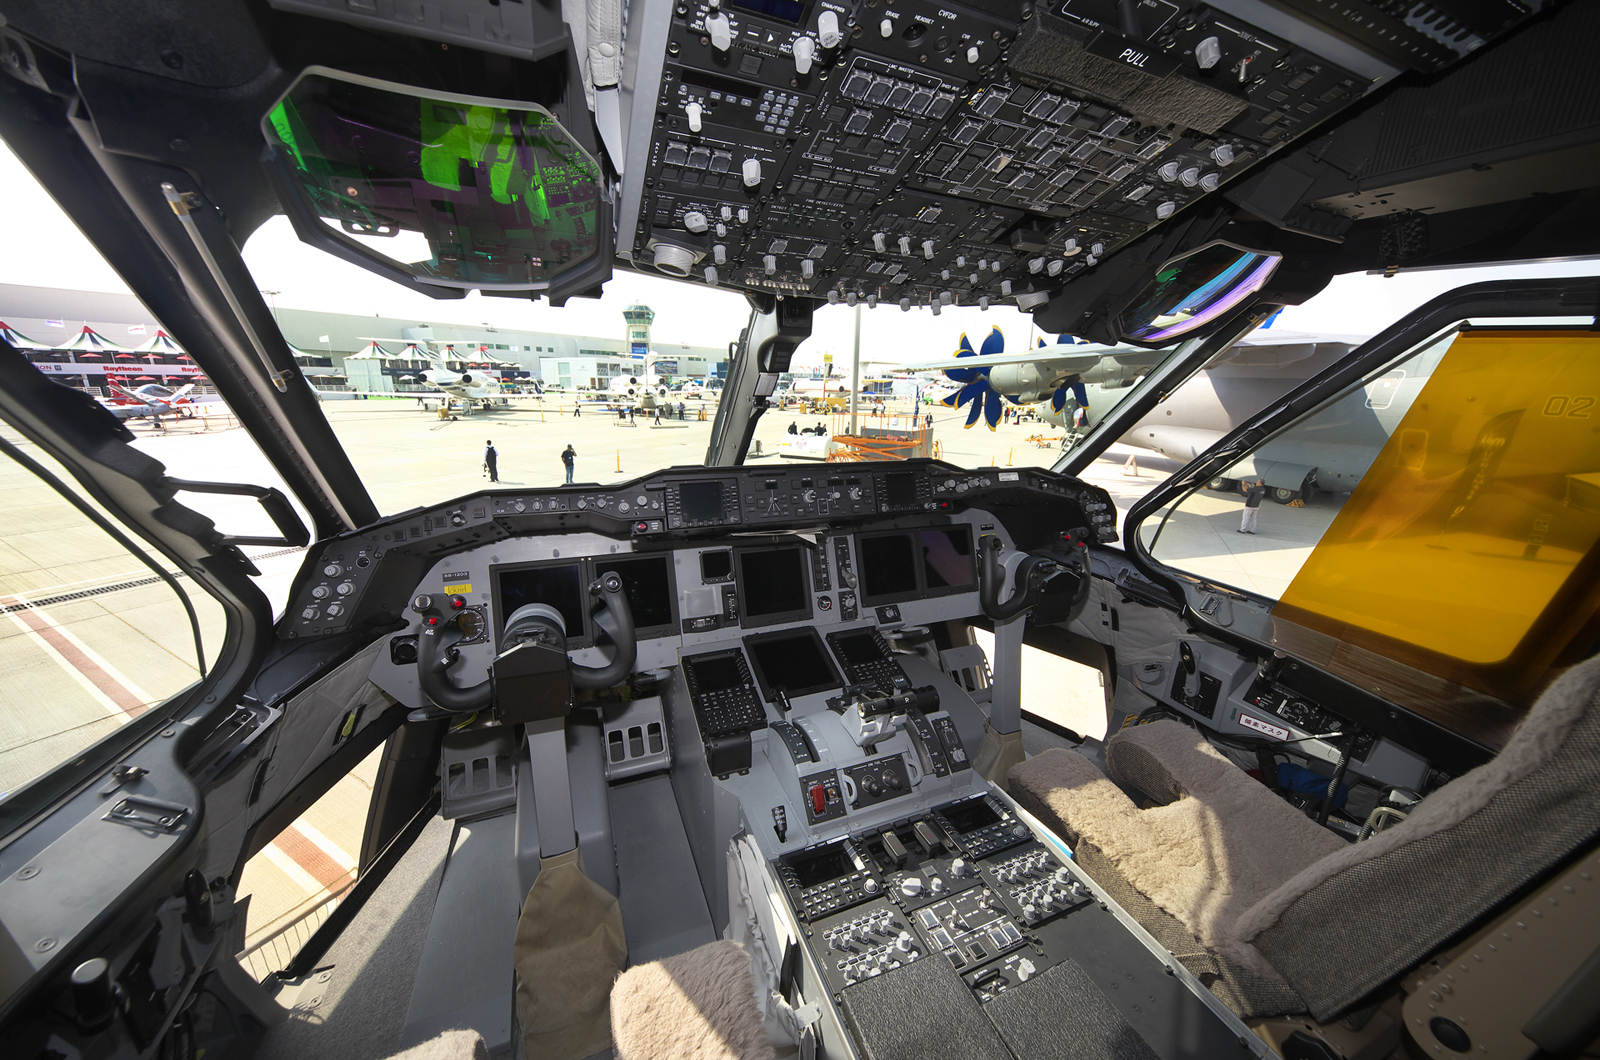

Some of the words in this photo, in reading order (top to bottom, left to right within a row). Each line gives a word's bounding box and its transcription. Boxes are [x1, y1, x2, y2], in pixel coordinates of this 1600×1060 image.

[885, 9, 900, 20] ERASE
[914, 14, 935, 25] HEADSET
[938, 9, 958, 21] CVFDR
[1118, 48, 1150, 68] PULL
[103, 365, 143, 373] Raytheon
[1541, 394, 1597, 419] 02
[1244, 717, 1283, 737] 酸素マスク
